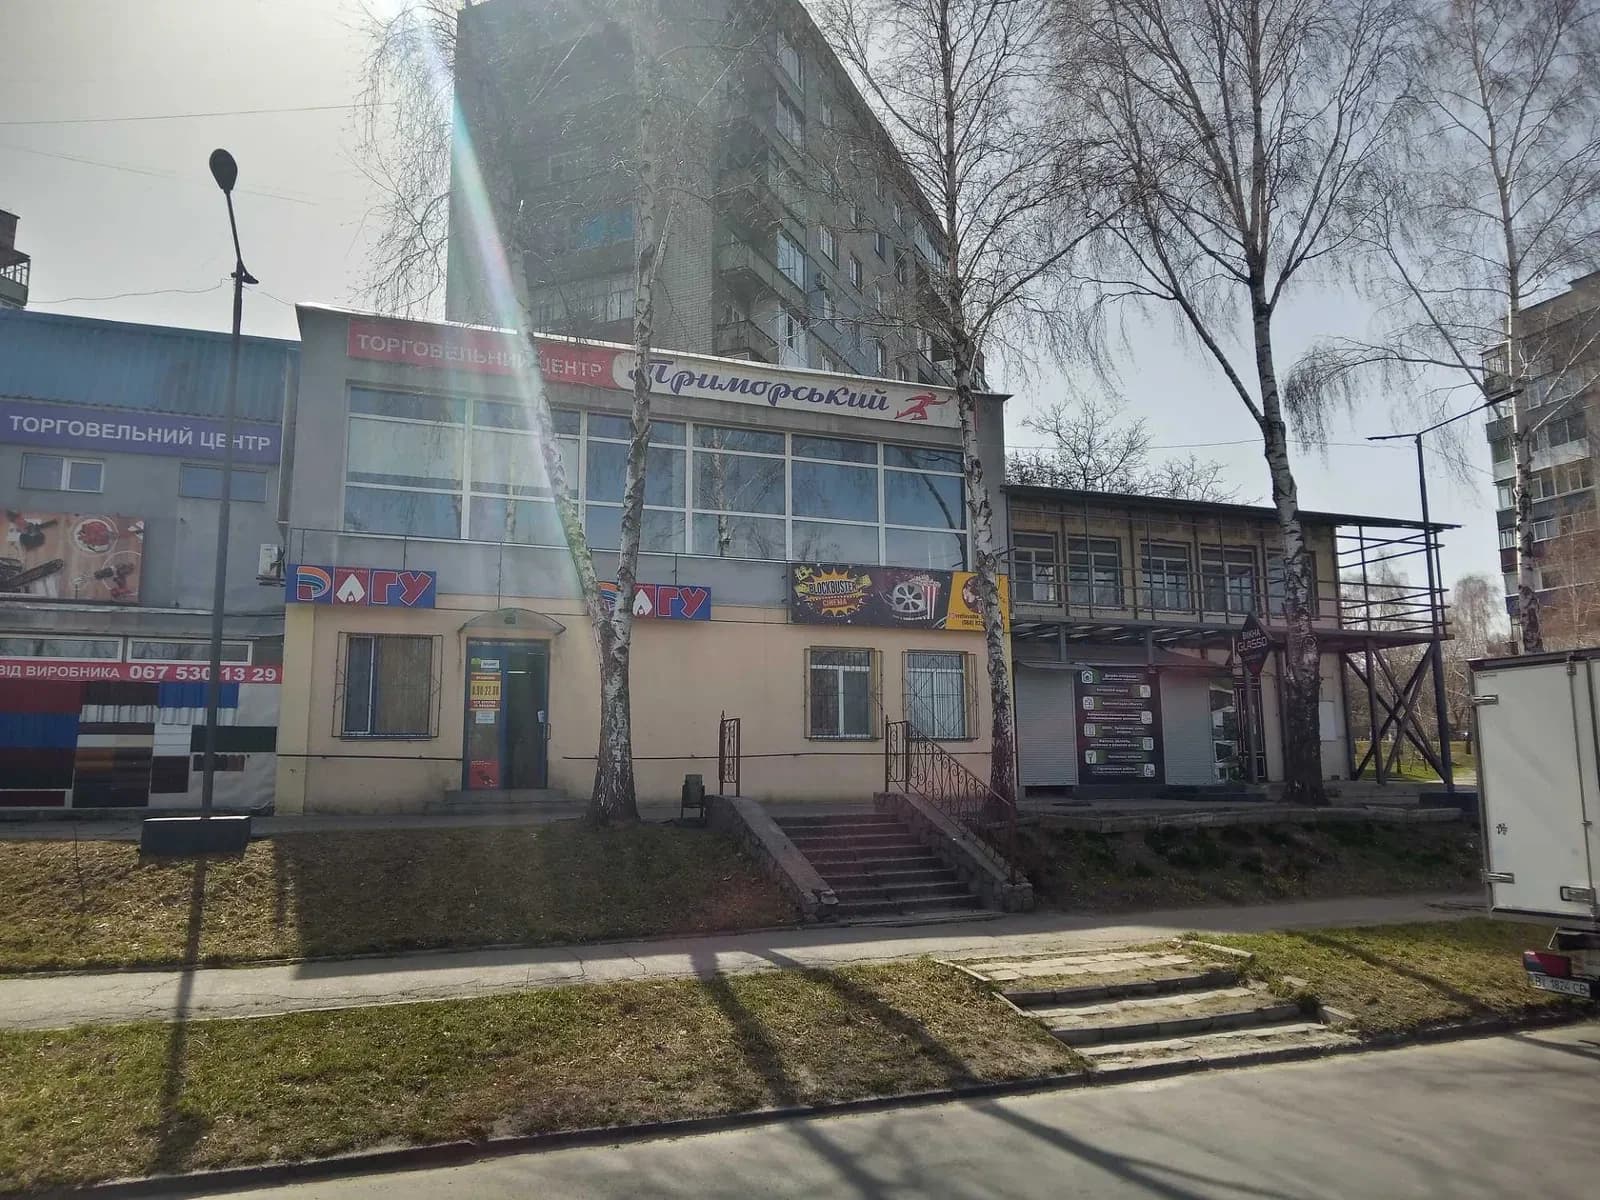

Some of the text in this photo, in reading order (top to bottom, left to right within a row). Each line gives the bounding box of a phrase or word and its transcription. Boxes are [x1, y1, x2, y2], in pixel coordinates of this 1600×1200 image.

[357, 335, 529, 369] ТОРГОВЕЛЬНИЙ
[627, 358, 890, 411] Приморський
[9, 414, 271, 451] ТОРГОВЕЛЬНИЙ ЦЕНТР
[296, 565, 433, 607] РАГУ
[808, 580, 860, 595] BLOCKBUSTER
[822, 598, 848, 607] CINEMA
[26, 665, 120, 678] ВИРОБНИКА
[129, 664, 167, 680] 067
[176, 665, 210, 680] 530
[221, 667, 246, 681] 13
[252, 667, 277, 682] 29
